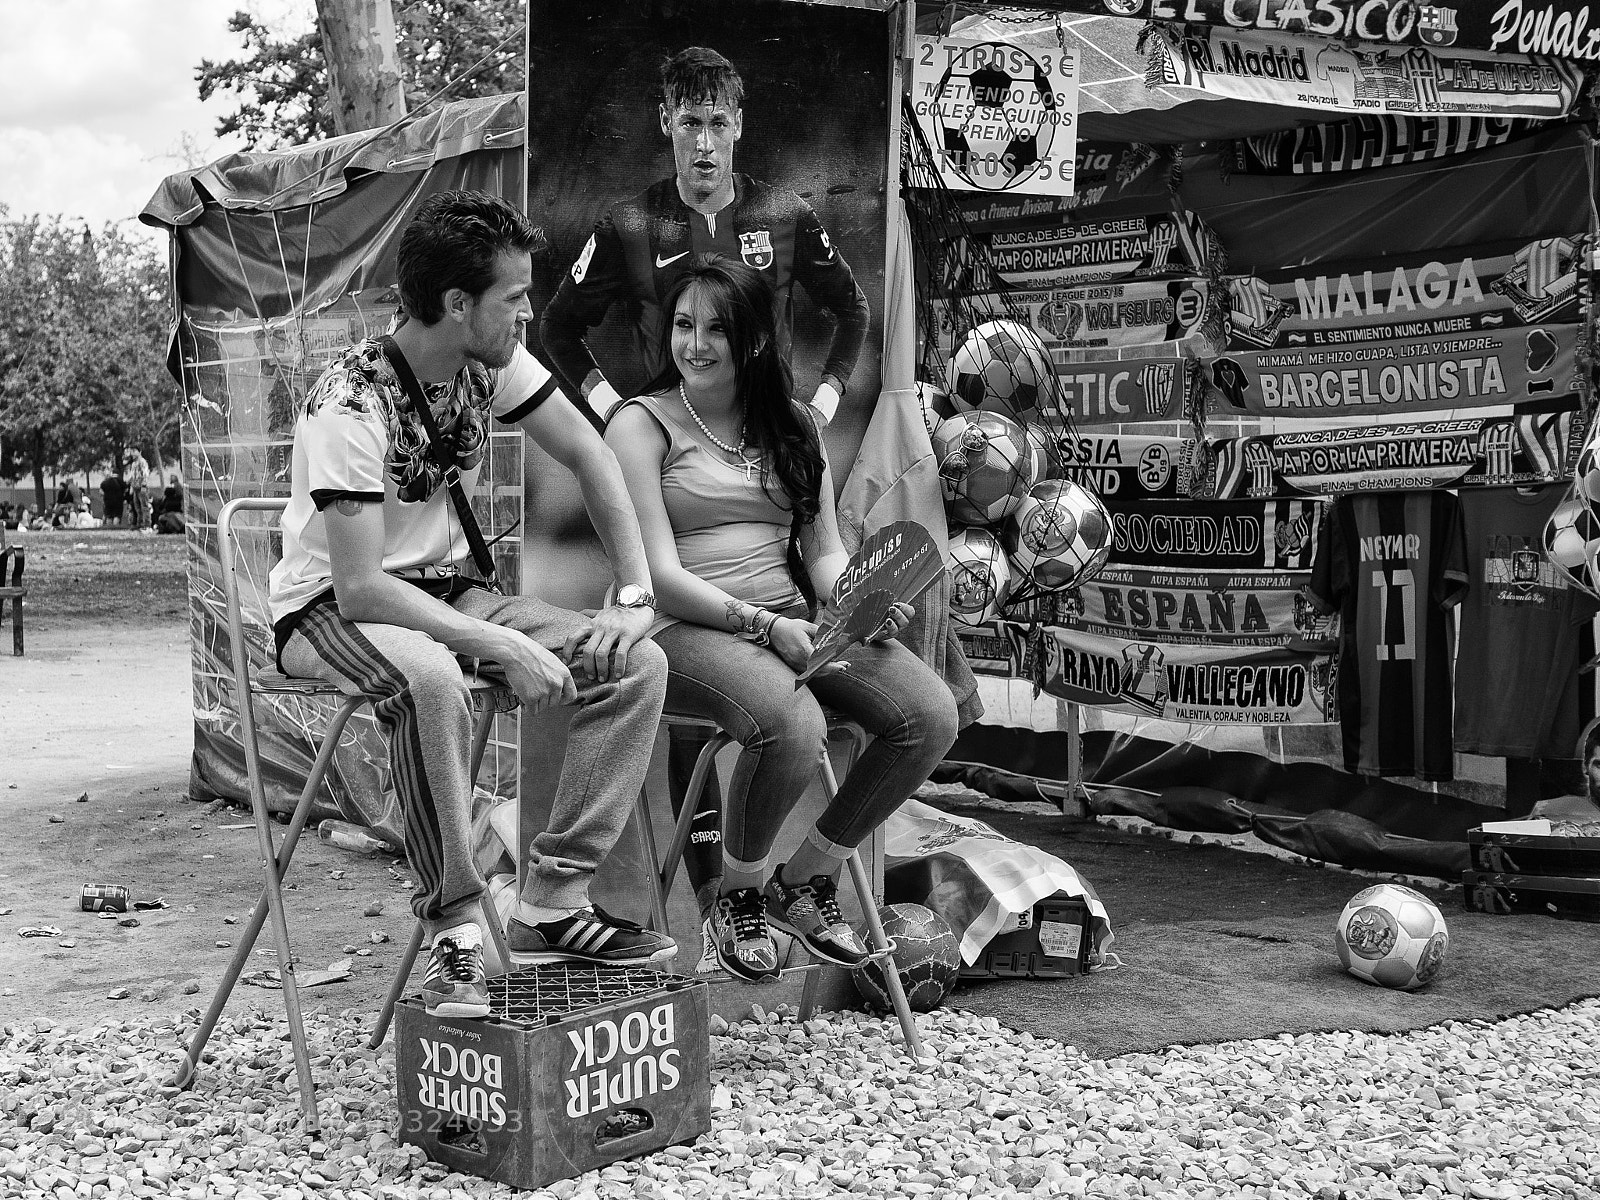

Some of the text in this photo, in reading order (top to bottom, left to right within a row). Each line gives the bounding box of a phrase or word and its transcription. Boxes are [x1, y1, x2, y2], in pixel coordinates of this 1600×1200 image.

[924, 83, 1066, 108] METIENDO DOS
[915, 101, 1073, 128] GOLES SEGUIDOS
[957, 123, 1031, 144] PREMIO
[1102, 218, 1146, 233] CREER
[996, 239, 1144, 272] A POR LA PRIMERA
[1057, 271, 1113, 286] CHAMPIONS
[1294, 257, 1485, 321] MALAGA
[1051, 289, 1085, 301] LEAGUE
[1084, 296, 1175, 330] WOLFSBURG
[1313, 317, 1472, 344] EL SENTIMIENTO NUNCA MUERE
[1257, 355, 1271, 368] MI
[1272, 351, 1304, 367] MAMÁ
[1309, 353, 1325, 366] ME
[1327, 350, 1353, 364] HIZO
[1355, 347, 1398, 362] GUAPA,
[1400, 342, 1430, 358] LISTA
[1432, 342, 1441, 354] Y
[1259, 354, 1507, 409] BARCELONISTA
[1420, 418, 1487, 435] CREER
[1282, 437, 1475, 476] A POR LA PRIMERA
[1320, 475, 1433, 493] FINAL CHAMPIONS
[1112, 512, 1260, 556] SOCIEDAD
[1360, 533, 1420, 562] NEYMAR
[1101, 570, 1134, 583] ESPAÑA
[1150, 573, 1209, 588] AUPA ESPAÑA
[1228, 574, 1292, 588] AUPA ESPAÑA
[1098, 586, 1271, 633] ESPAÑA
[1086, 624, 1108, 637] AUPA
[1063, 647, 1122, 698] RAYO
[1166, 663, 1306, 707] VALLECANO
[1214, 709, 1241, 725] CORAJE
[1250, 710, 1291, 727] NOBLEZA
[690, 830, 721, 844] BARÇA
[566, 1001, 676, 1072] BOCK
[418, 1037, 503, 1090] BOCK
[563, 1047, 681, 1119] SUPER
[416, 1072, 508, 1127] SUPER
